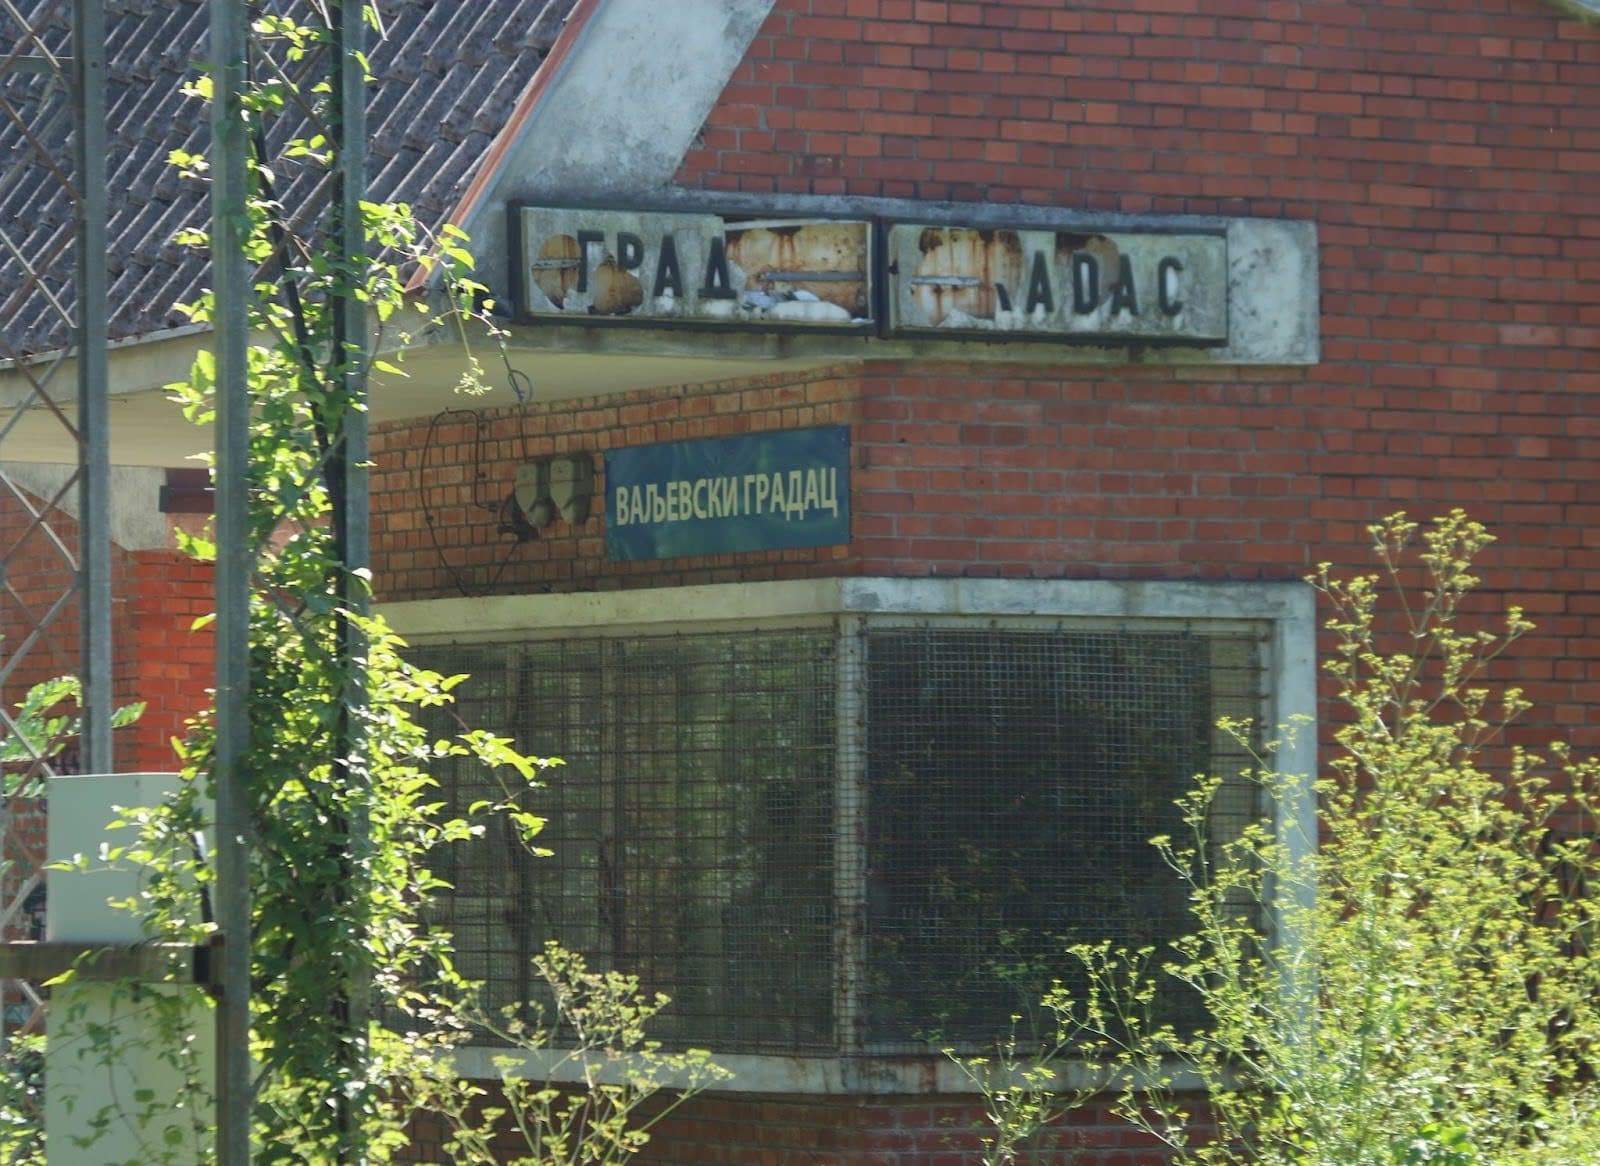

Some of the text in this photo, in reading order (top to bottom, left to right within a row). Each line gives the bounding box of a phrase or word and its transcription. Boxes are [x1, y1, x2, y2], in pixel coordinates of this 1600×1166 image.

[576, 229, 738, 300] ГРАД
[994, 250, 1184, 317] ADAC
[615, 466, 839, 526] ВАЉЕВСКИ ГРАДАЦ
